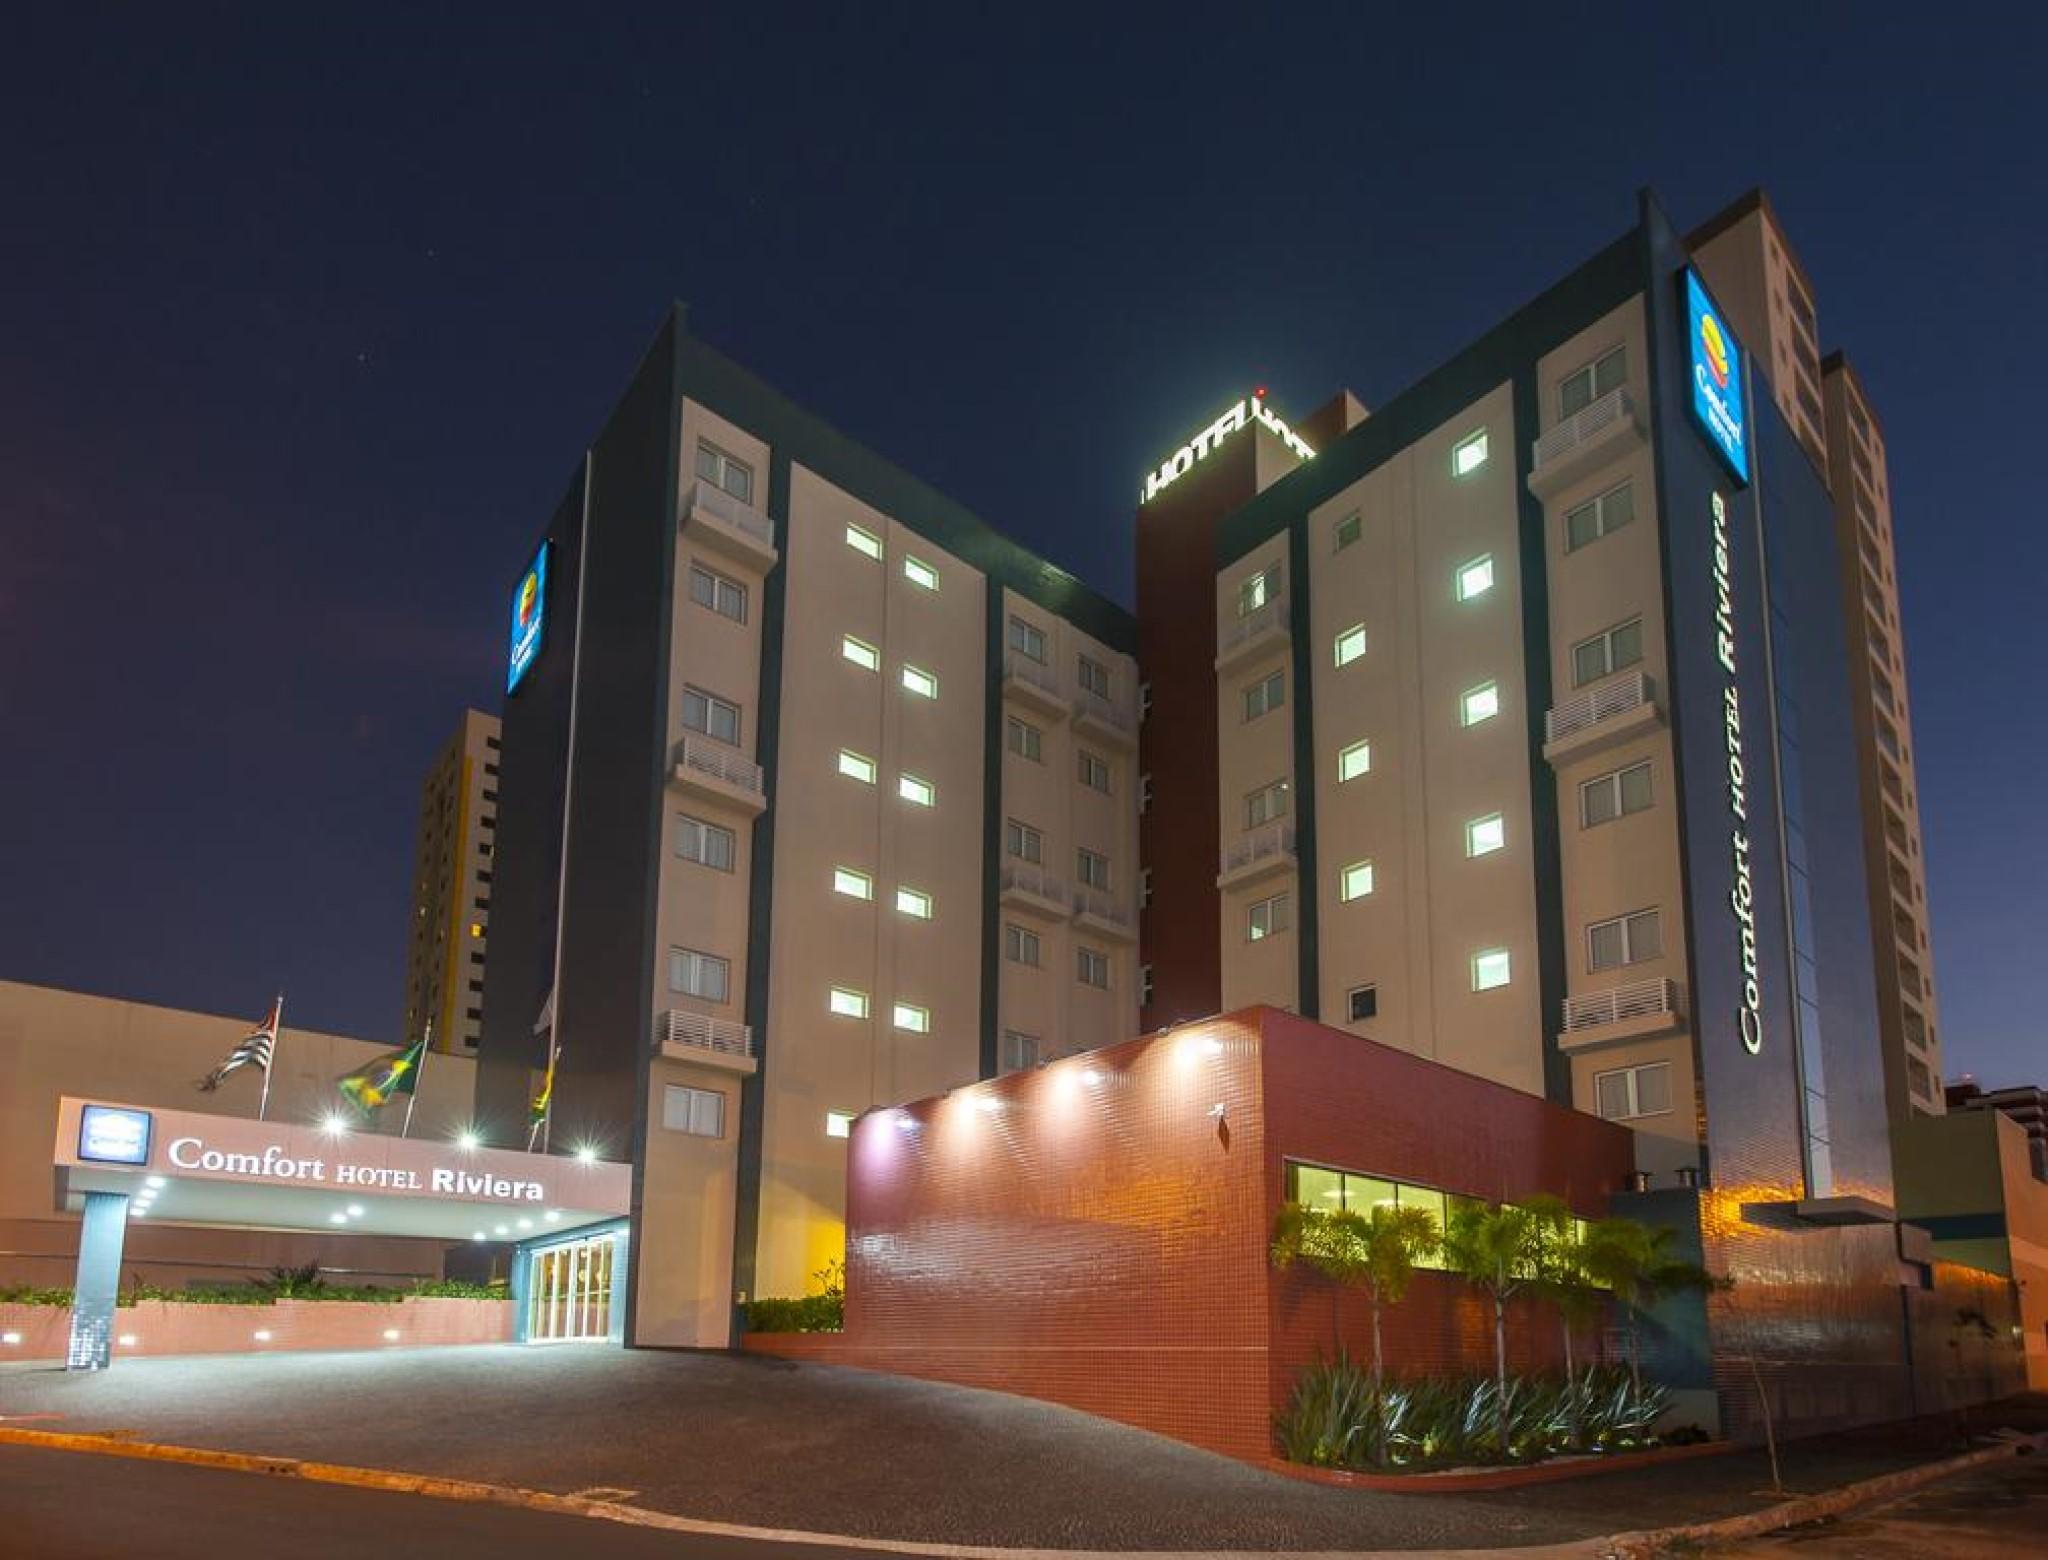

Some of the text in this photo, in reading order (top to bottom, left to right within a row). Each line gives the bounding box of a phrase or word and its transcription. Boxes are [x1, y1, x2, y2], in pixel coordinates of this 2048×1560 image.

[1712, 491, 1762, 1055] Comfort HOTEL Riviera
[168, 1137, 325, 1180] Comfort
[336, 1164, 422, 1190] HOTEL
[431, 1168, 544, 1201] Riviera
